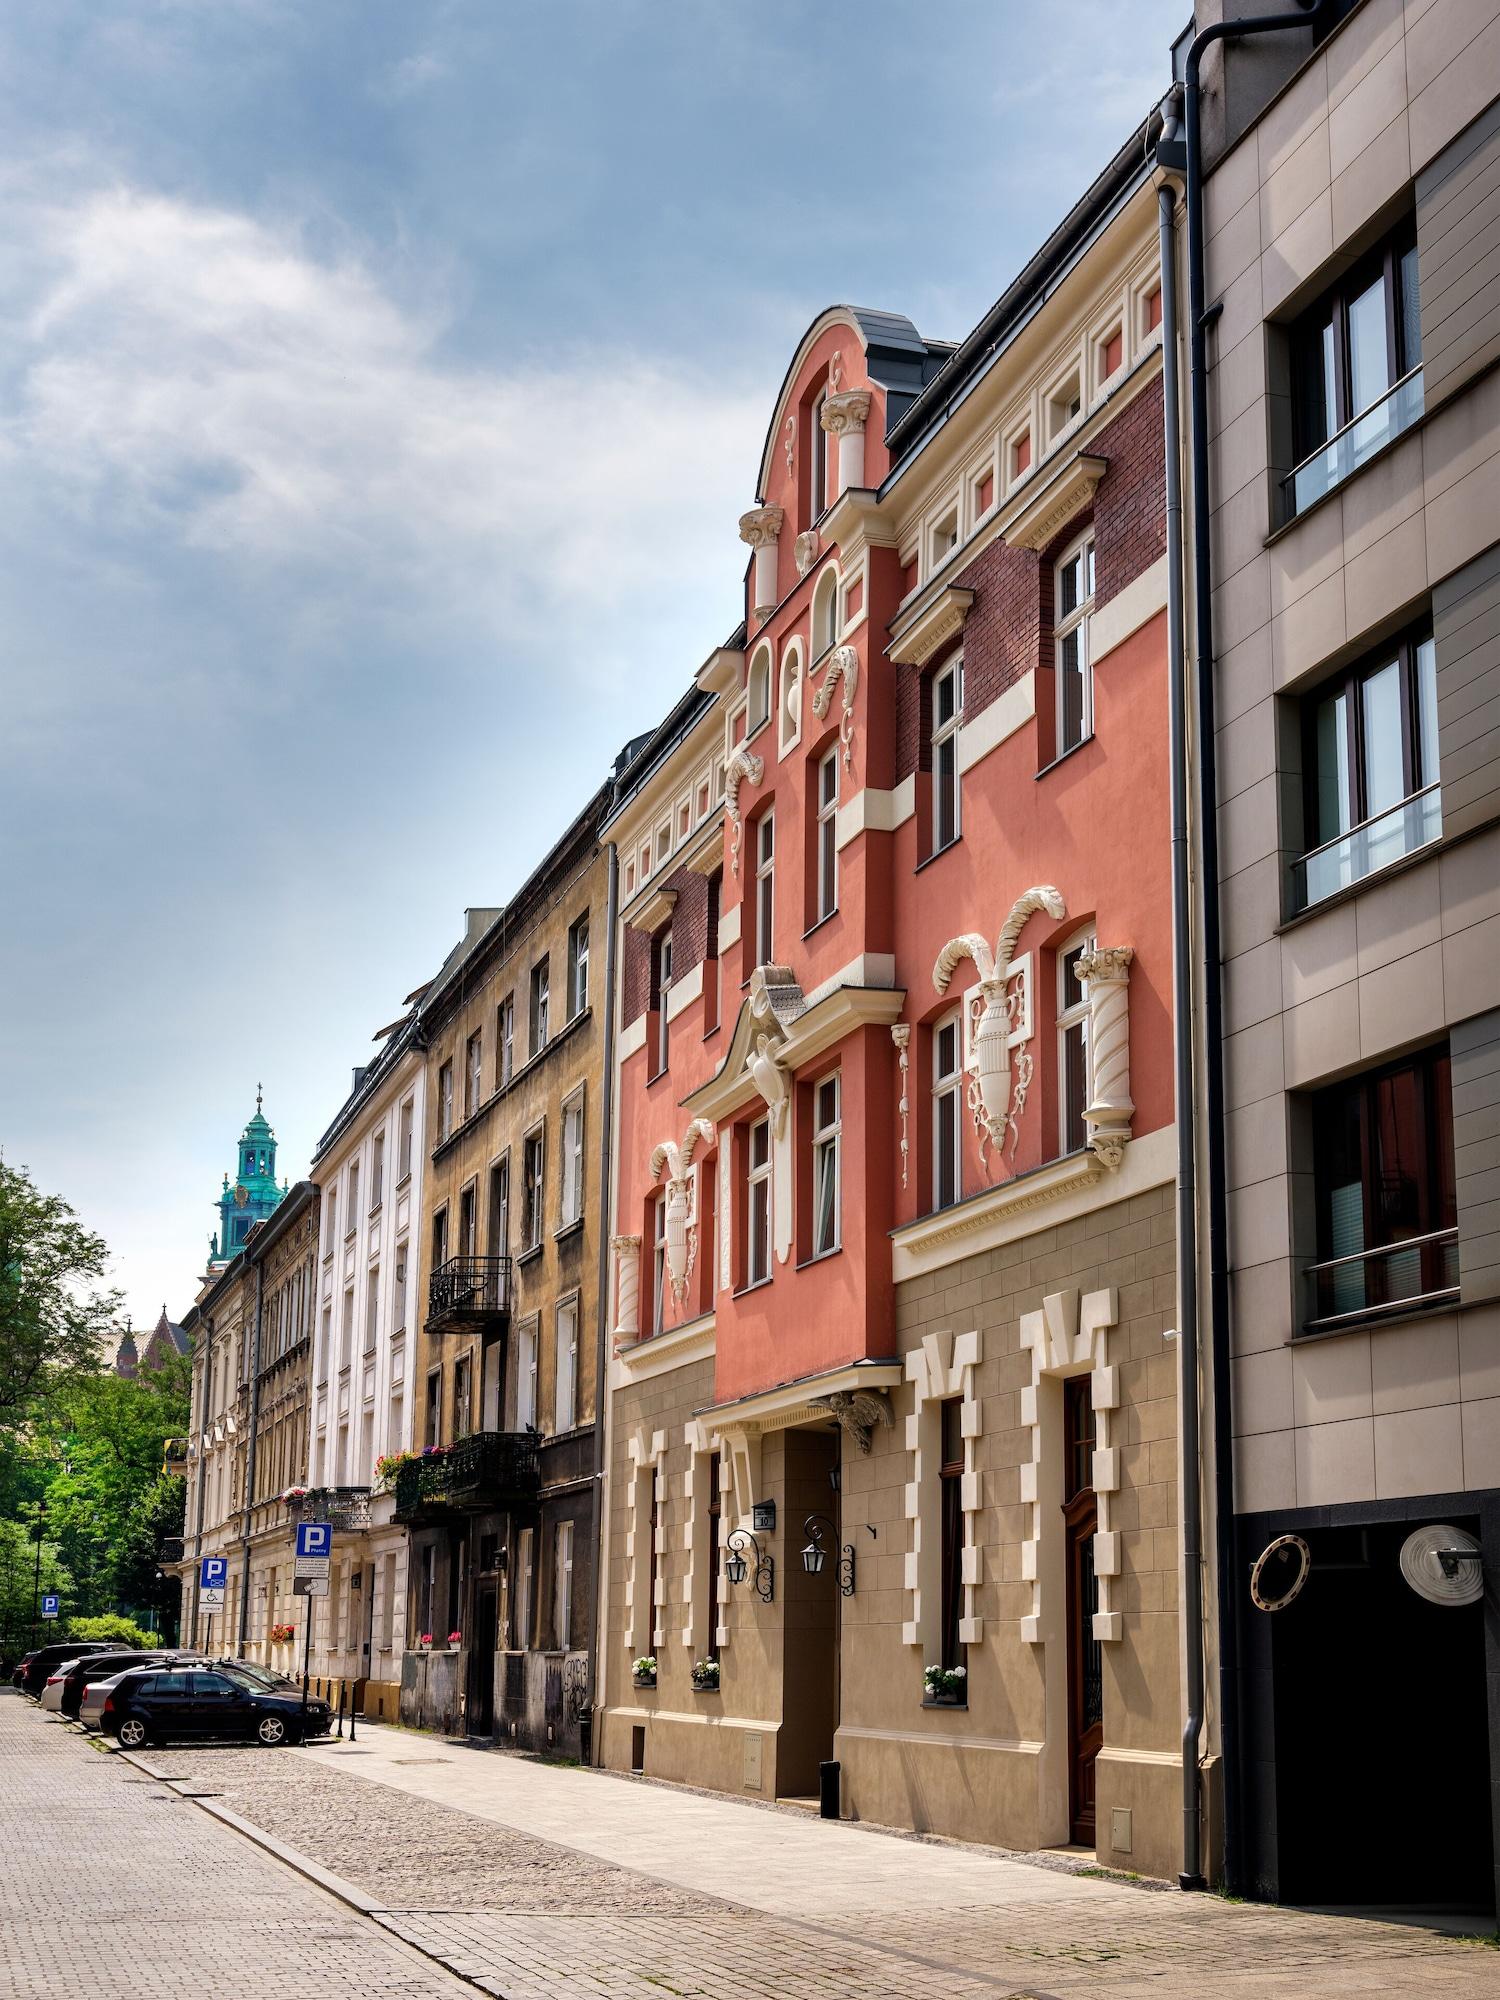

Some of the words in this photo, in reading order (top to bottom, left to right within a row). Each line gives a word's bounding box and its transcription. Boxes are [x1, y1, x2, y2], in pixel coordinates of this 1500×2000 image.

[761, 1517, 769, 1526] 10
[304, 1527, 325, 1552] P
[207, 1561, 222, 1579] P
[45, 1598, 55, 1610] P
